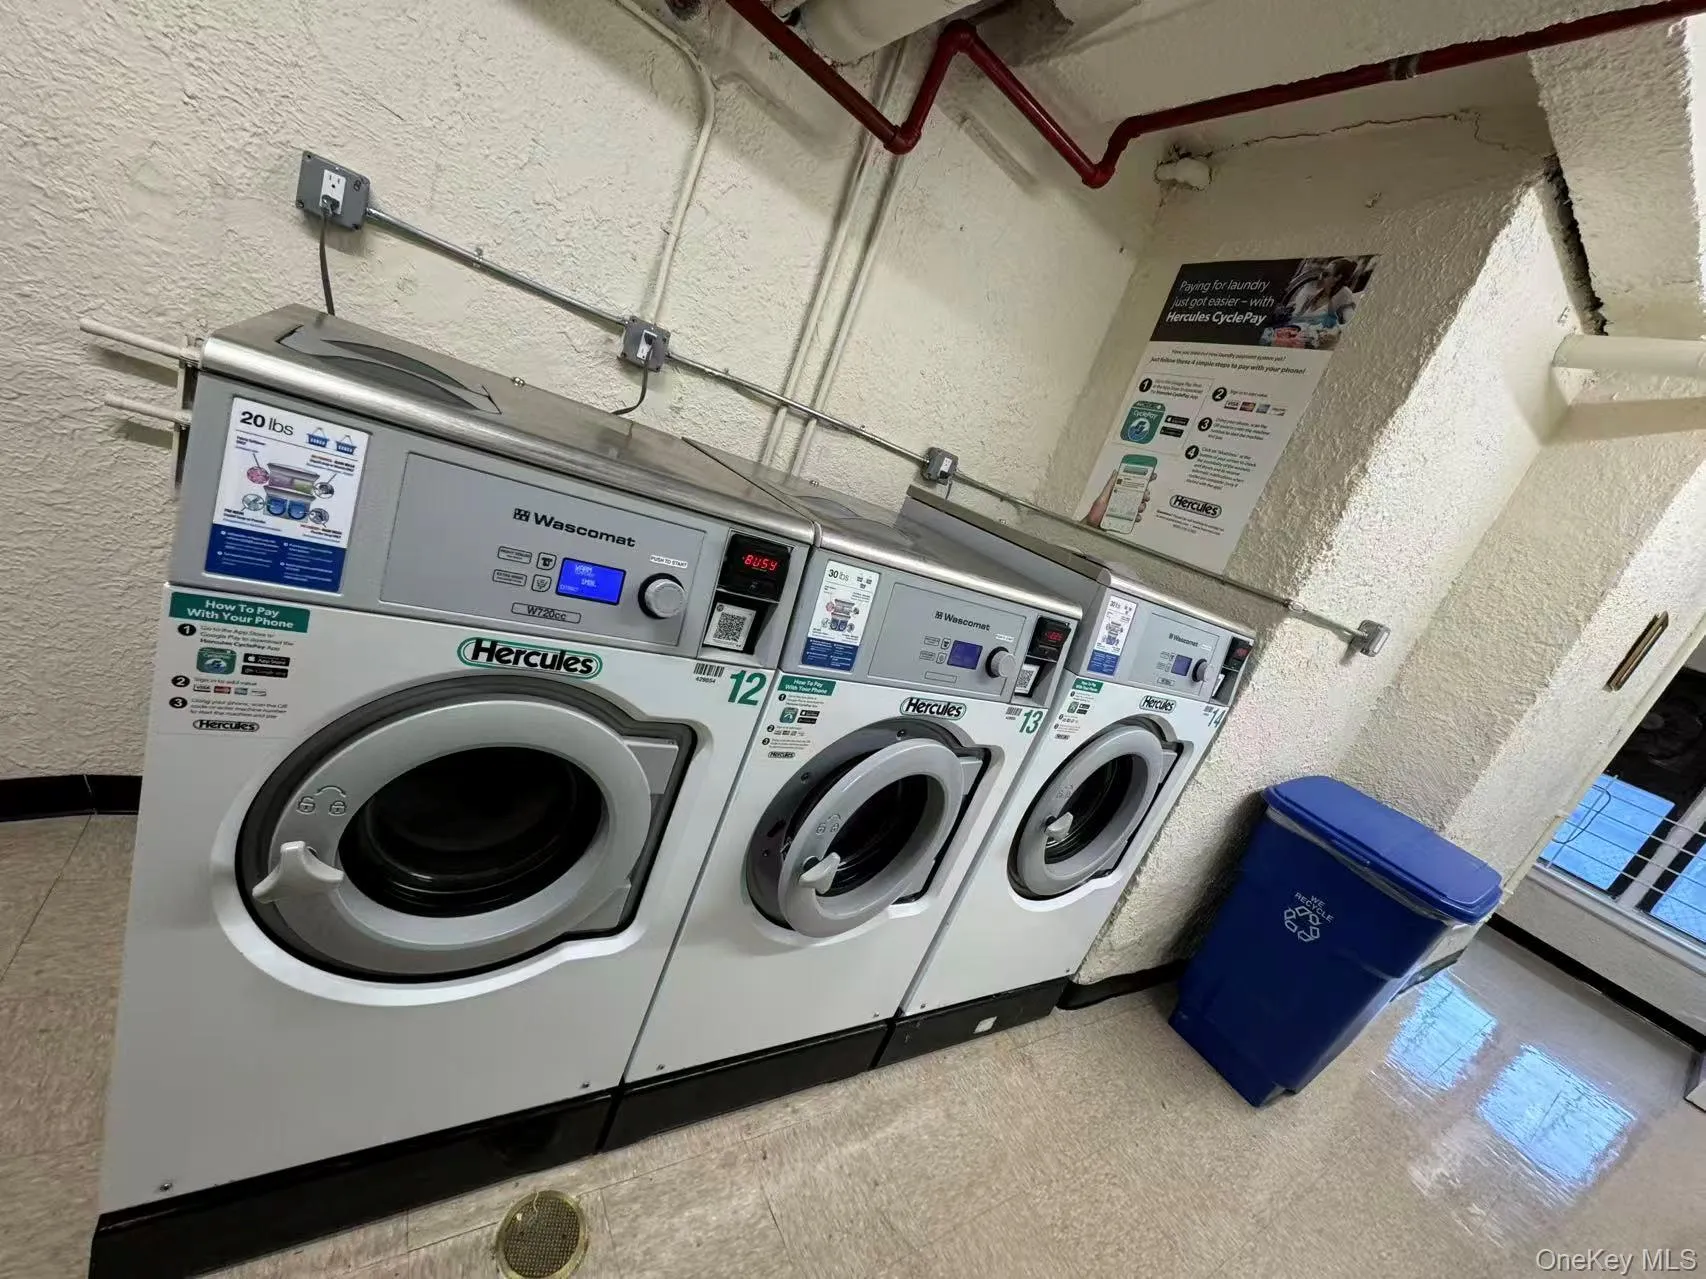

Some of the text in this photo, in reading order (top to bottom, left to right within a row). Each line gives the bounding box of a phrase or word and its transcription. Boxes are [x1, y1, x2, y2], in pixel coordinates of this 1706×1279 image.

[1180, 280, 1270, 294] Paying for laundry
[1170, 296, 1190, 309] just
[1190, 296, 1208, 308] got
[1208, 295, 1240, 306] easier
[1249, 296, 1275, 307] with
[1166, 311, 1267, 326] Hercules CyclePay
[1281, 367, 1306, 375] phone!
[240, 411, 294, 436] 20 lbs
[1173, 495, 1218, 516] Hercules
[532, 511, 636, 548] Wascomat
[650, 556, 665, 564] PUSH
[828, 569, 839, 579] 30
[205, 600, 280, 618] How To Pay
[527, 604, 566, 621] W720cc
[187, 608, 294, 629] With Your Phone
[944, 612, 991, 631] Wascomat
[234, 642, 265, 650] CyclePay
[1173, 634, 1198, 647] Wascomat
[471, 638, 594, 676] Hercules
[728, 670, 766, 706] 12
[902, 698, 963, 719] Hercules
[1142, 696, 1174, 711] Hercules
[200, 720, 255, 731] Hercules
[1019, 710, 1044, 734] 13
[1208, 708, 1226, 728] 14
[1294, 892, 1334, 922] RECYCLE
[1310, 896, 1325, 908] WE
